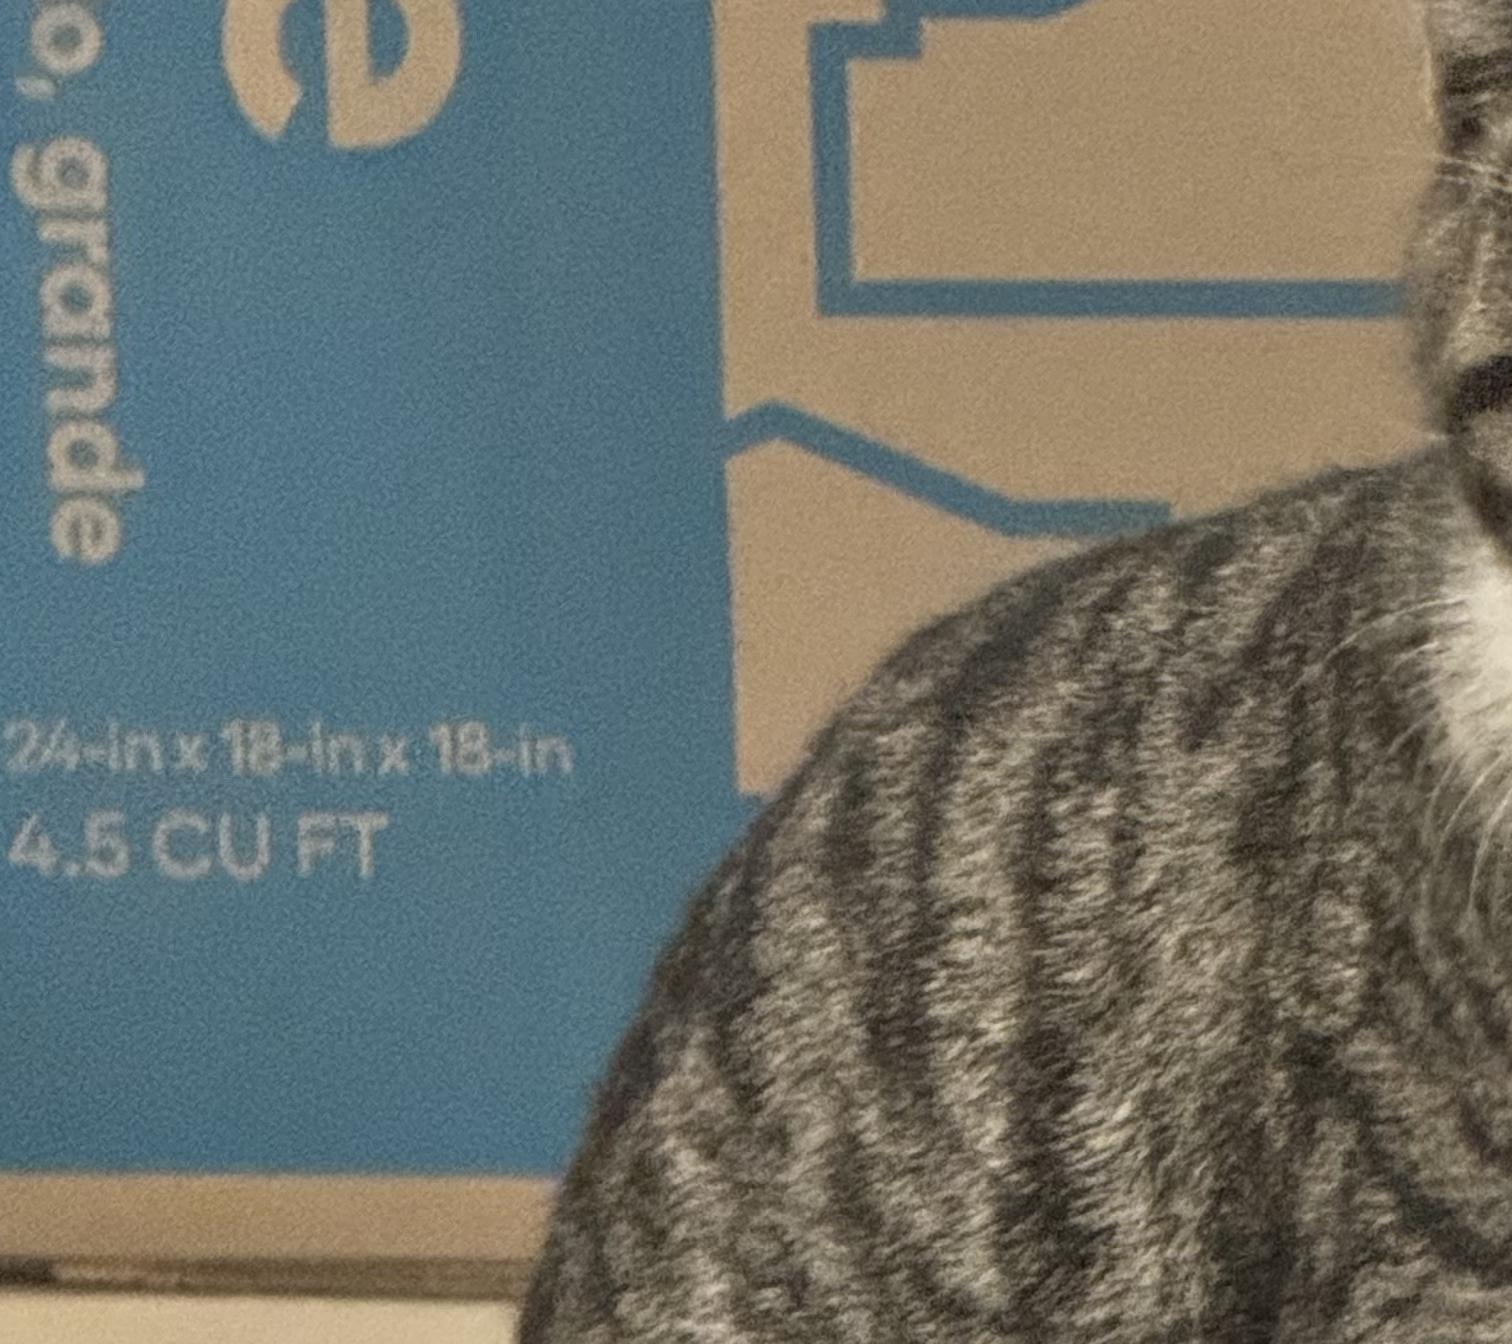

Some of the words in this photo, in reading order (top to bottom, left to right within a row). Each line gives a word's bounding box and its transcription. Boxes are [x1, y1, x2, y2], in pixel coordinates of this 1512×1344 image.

[9, 135, 146, 566] grande
[3, 717, 164, 773] 24-in
[175, 730, 208, 773] x
[221, 717, 364, 777] 18-in
[376, 731, 410, 777] x
[429, 719, 575, 778] 18-in
[7, 810, 131, 877] 4.5
[152, 808, 271, 882] CU
[296, 811, 389, 879] FT
